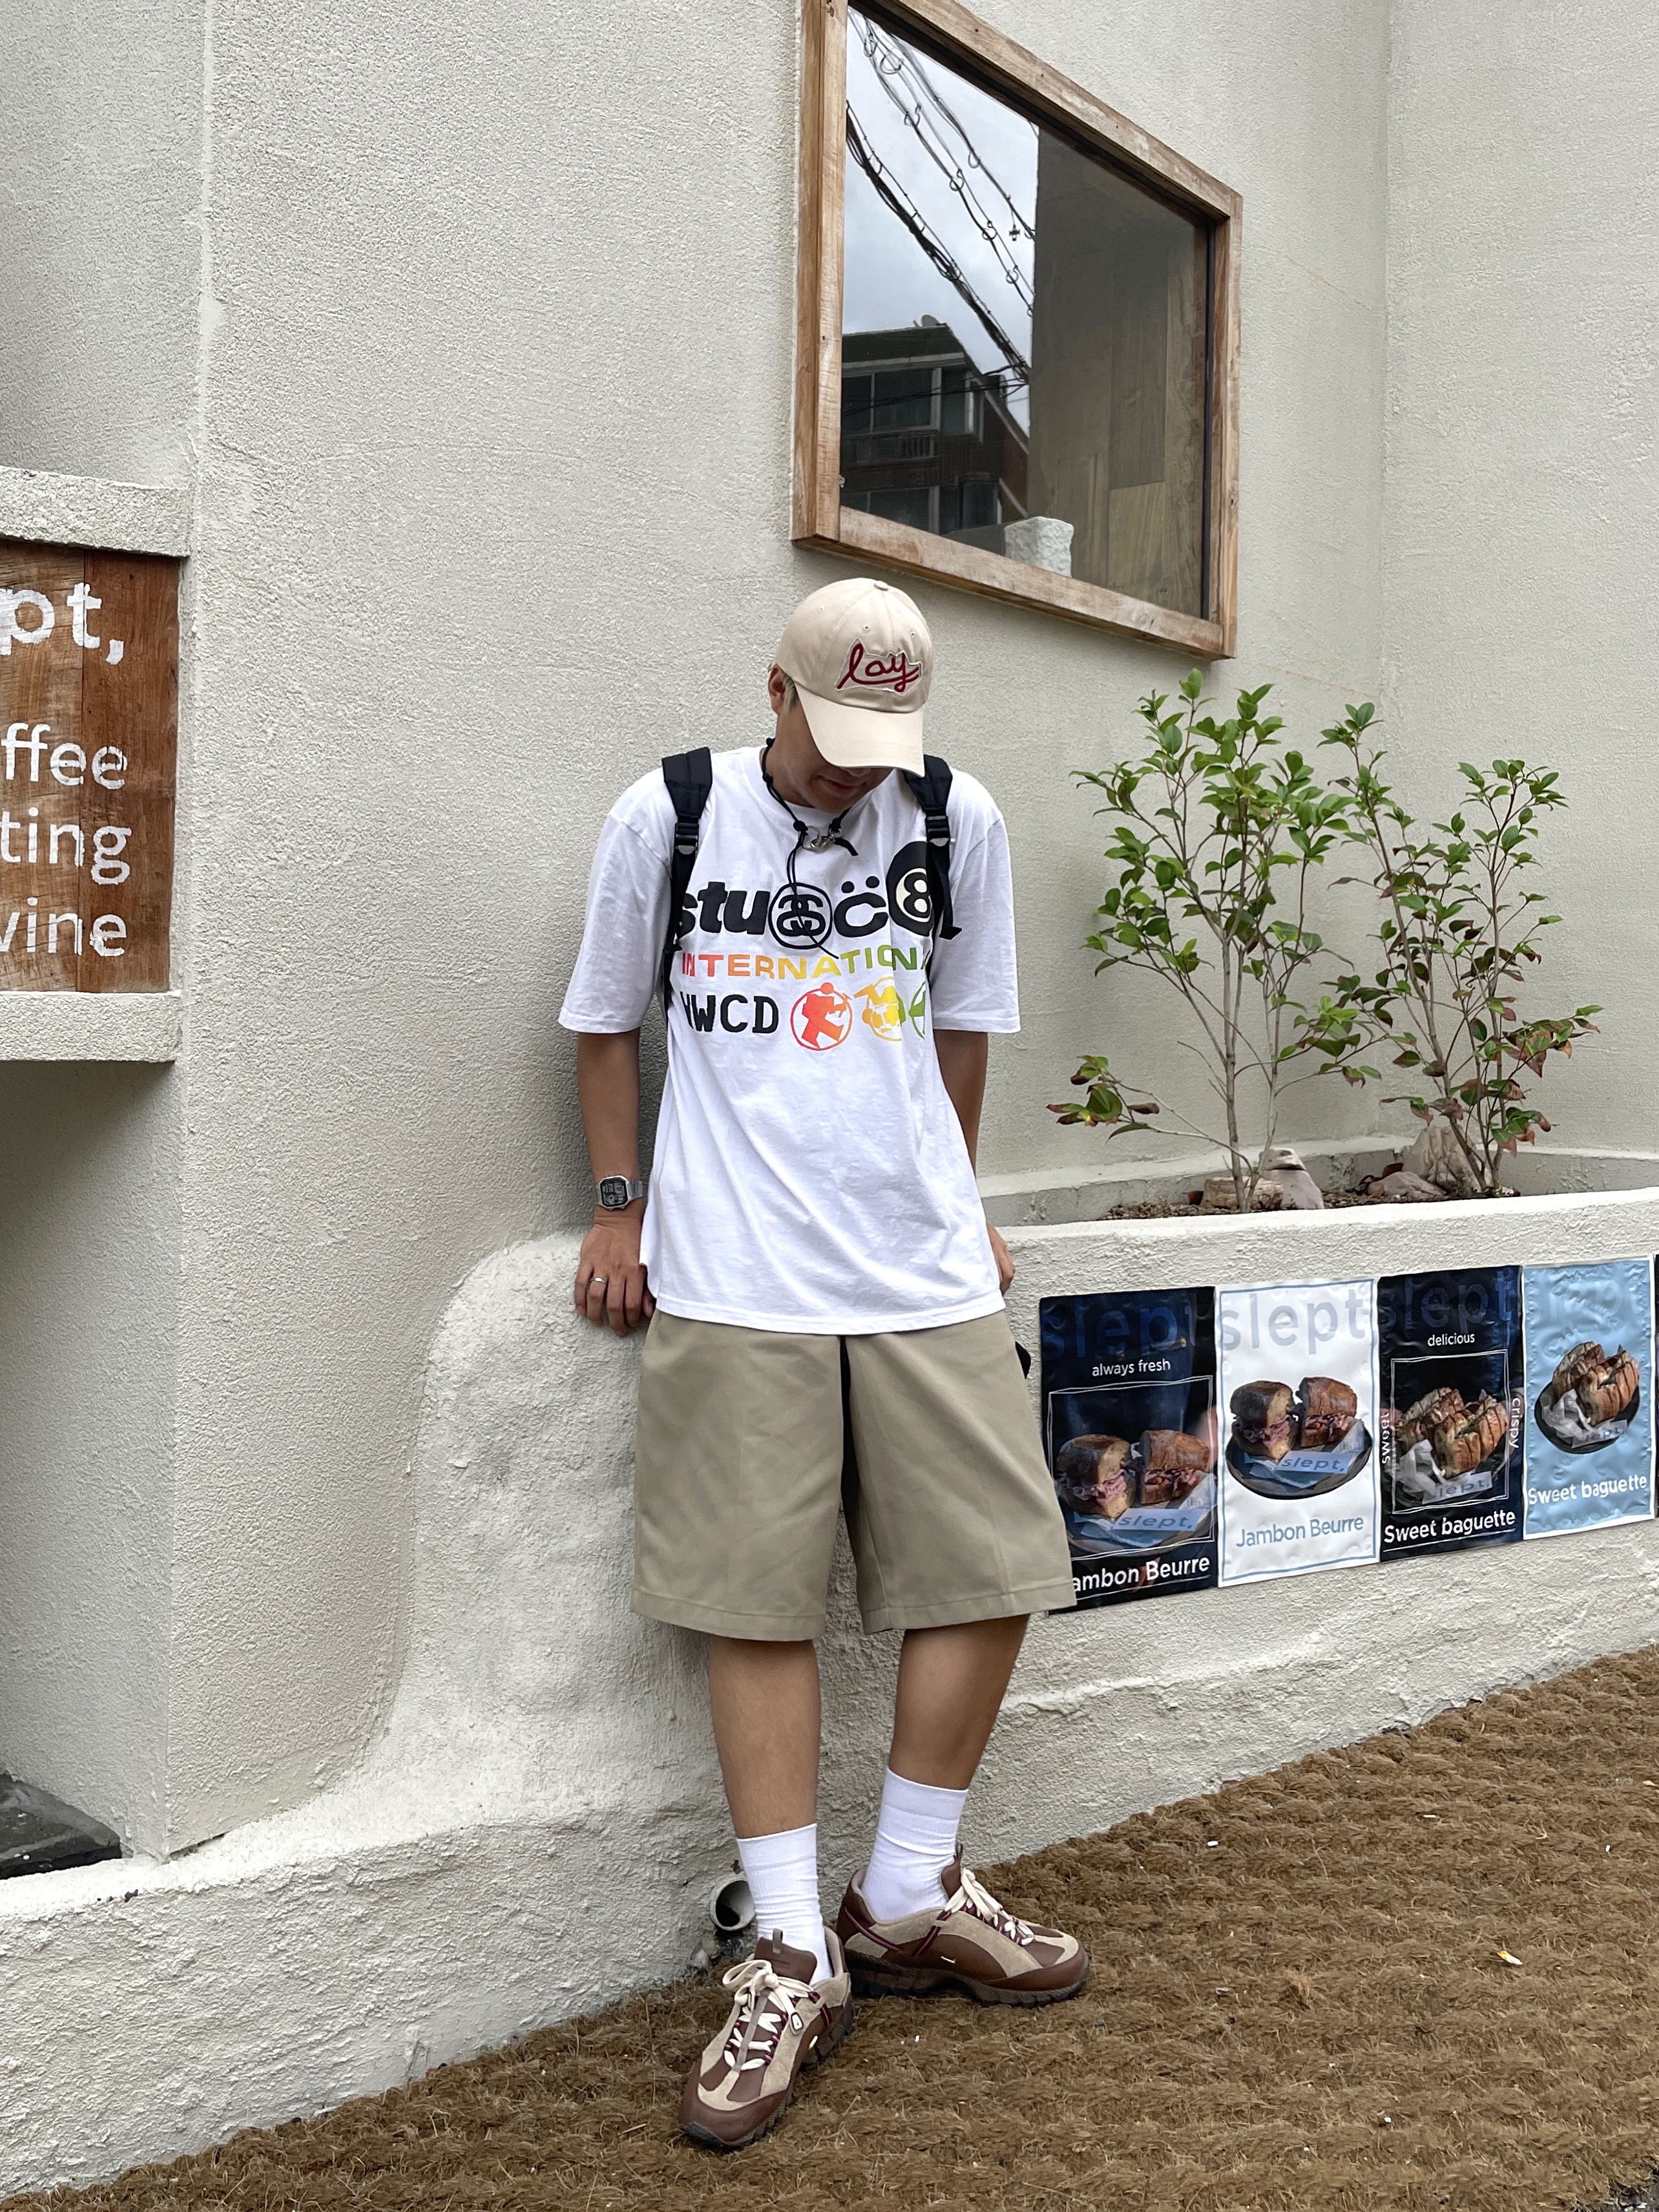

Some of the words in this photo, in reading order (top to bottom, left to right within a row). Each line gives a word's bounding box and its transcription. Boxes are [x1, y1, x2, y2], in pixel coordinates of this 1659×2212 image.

[1, 722, 128, 789] ffee
[0, 807, 132, 885] ting
[682, 944, 931, 980] INTERNATION
[1428, 1332, 1476, 1347] delicious
[1092, 1364, 1135, 1377] always
[1138, 1358, 1171, 1373] fresh
[1509, 1398, 1523, 1449] crispy
[1528, 1484, 1577, 1506] Sweet
[1581, 1474, 1647, 1498] baguette
[1236, 1524, 1306, 1548] Jambon
[1309, 1517, 1364, 1538] Beurre
[1384, 1520, 1437, 1543] Sweet
[1441, 1510, 1516, 1535] baguette
[1073, 1568, 1140, 1592] ambon
[1145, 1557, 1210, 1581] Beurre
